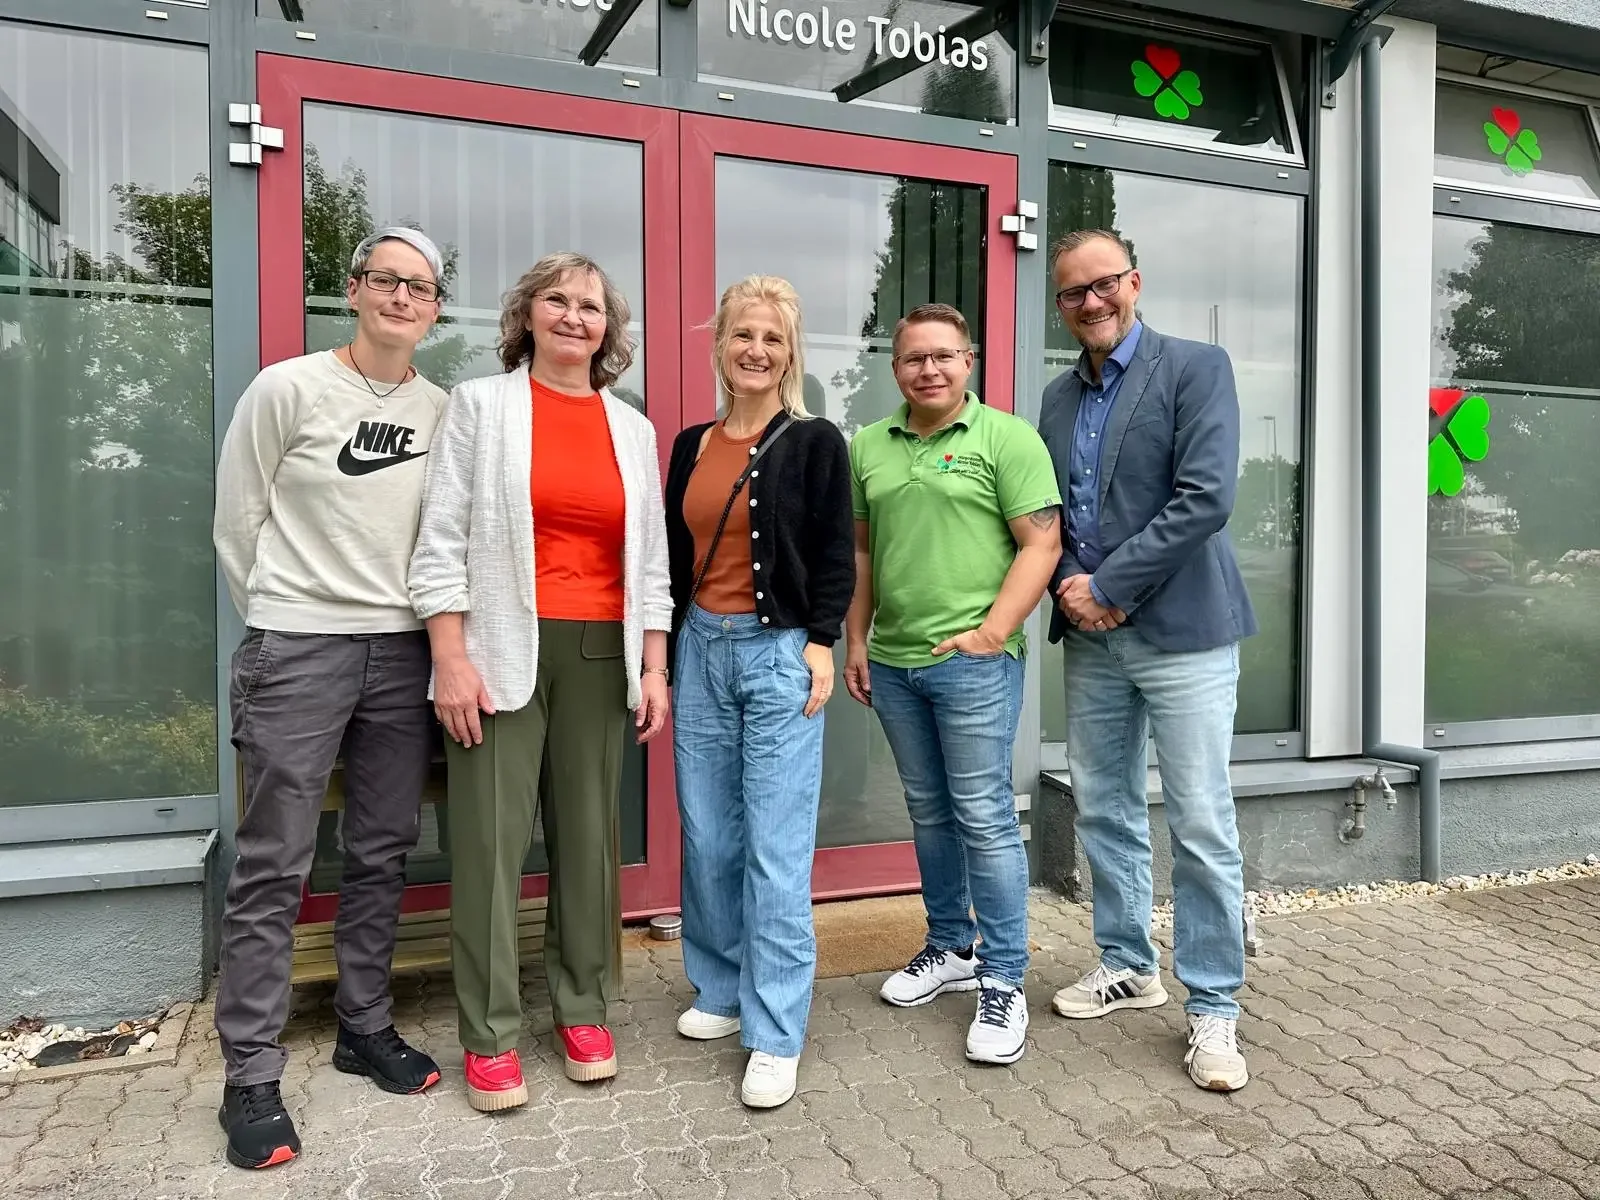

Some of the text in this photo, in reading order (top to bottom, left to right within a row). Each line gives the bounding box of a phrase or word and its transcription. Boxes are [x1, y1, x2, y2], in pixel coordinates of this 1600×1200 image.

[728, 0, 988, 71] Nicole Tobias
[353, 421, 415, 455] NIKE
